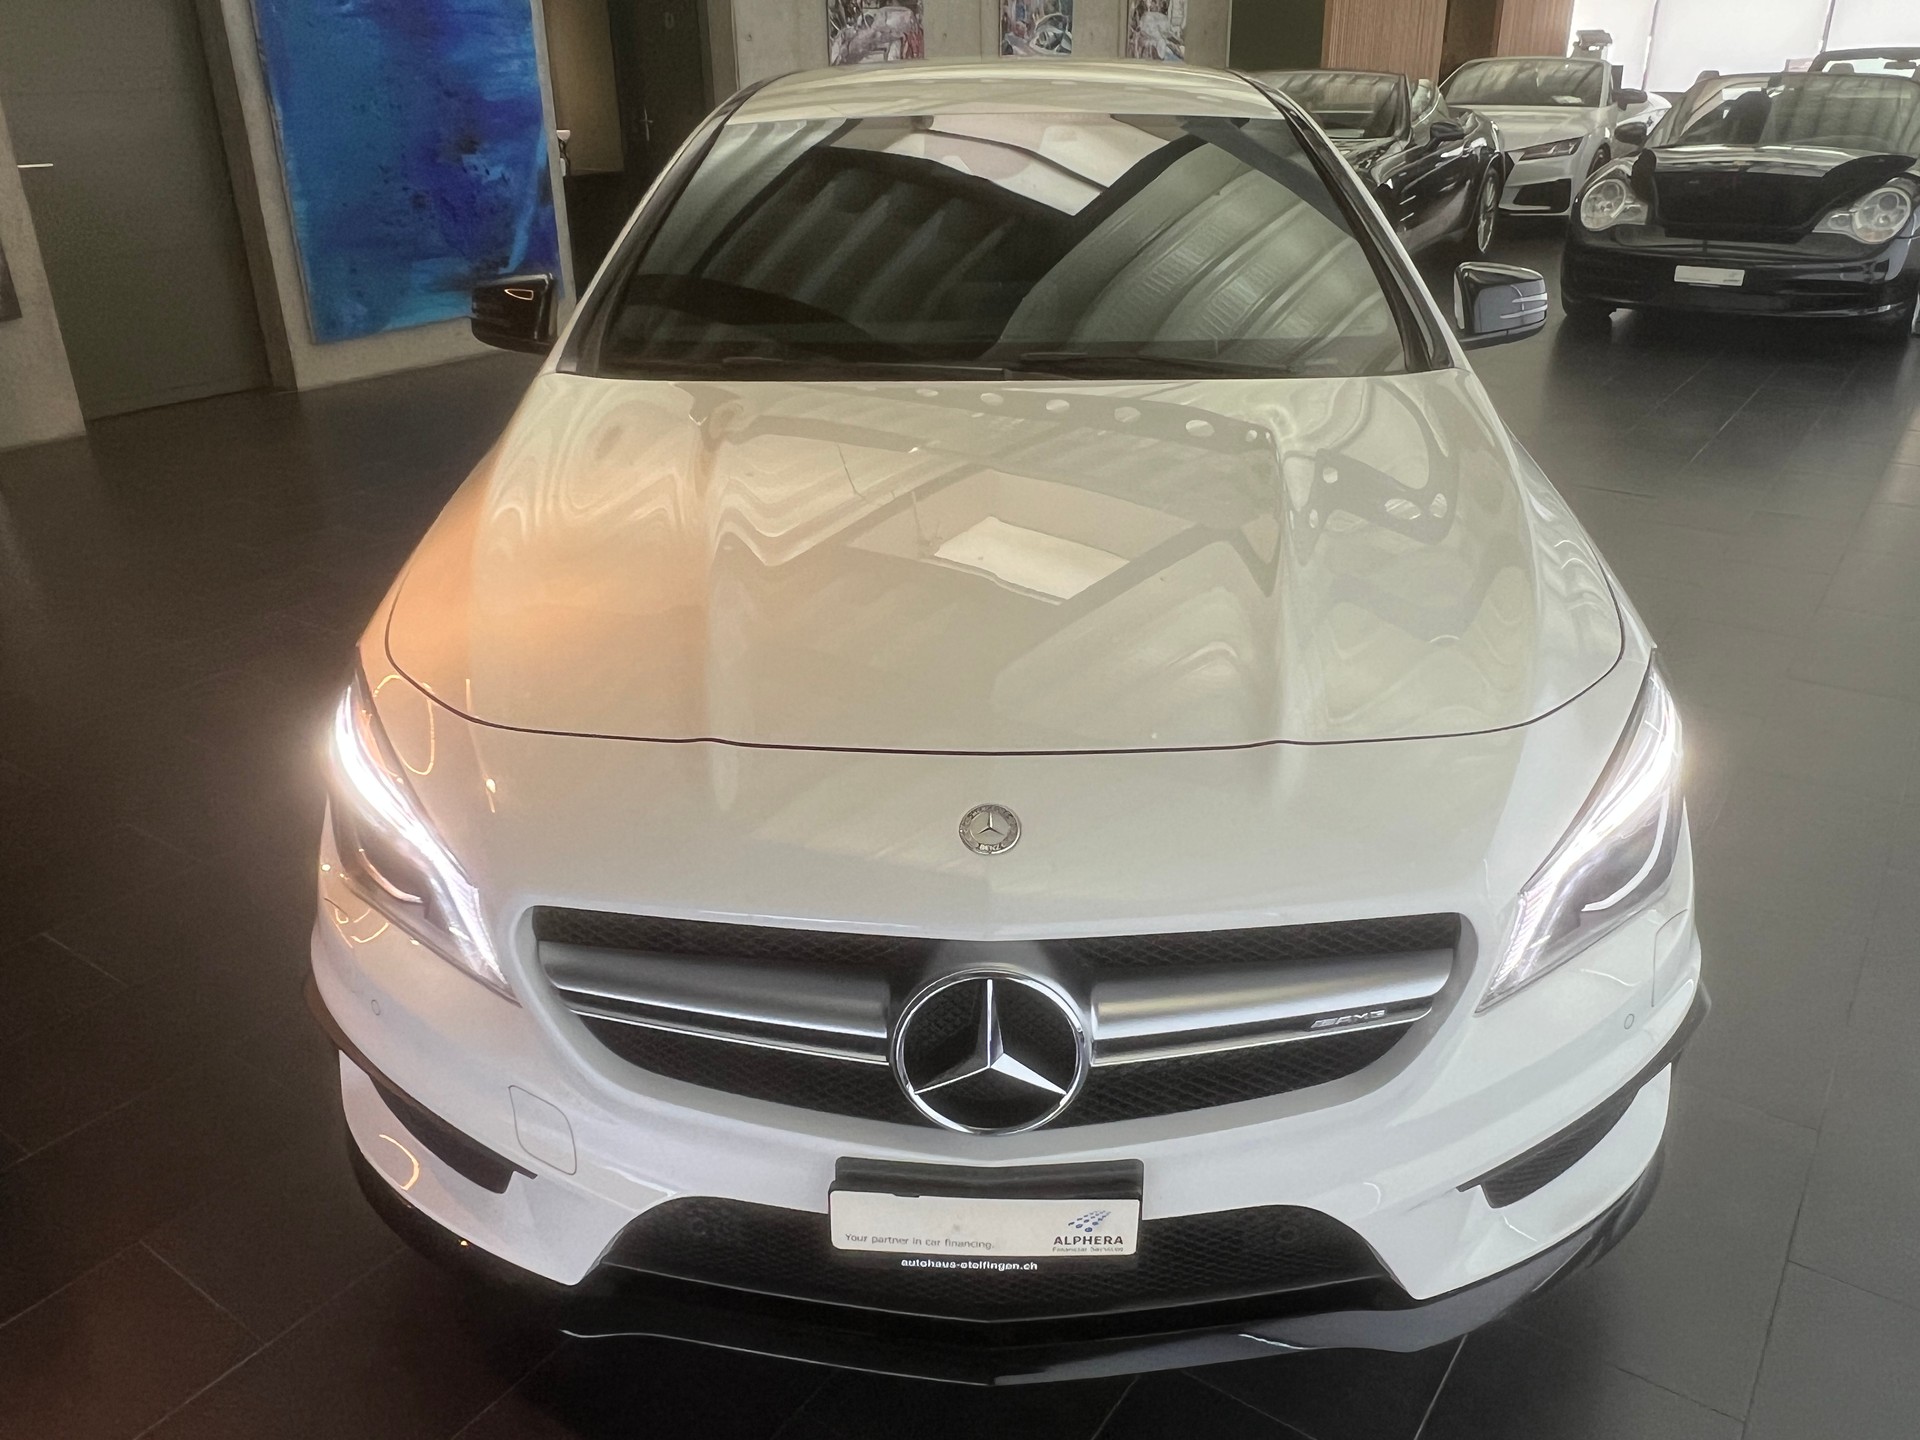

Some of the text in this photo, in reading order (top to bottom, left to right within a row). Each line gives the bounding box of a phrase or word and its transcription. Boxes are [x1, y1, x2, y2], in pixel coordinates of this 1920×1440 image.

[845, 1233, 995, 1251] Your partner in car financing.
[1053, 1235, 1124, 1246] ALPHERA
